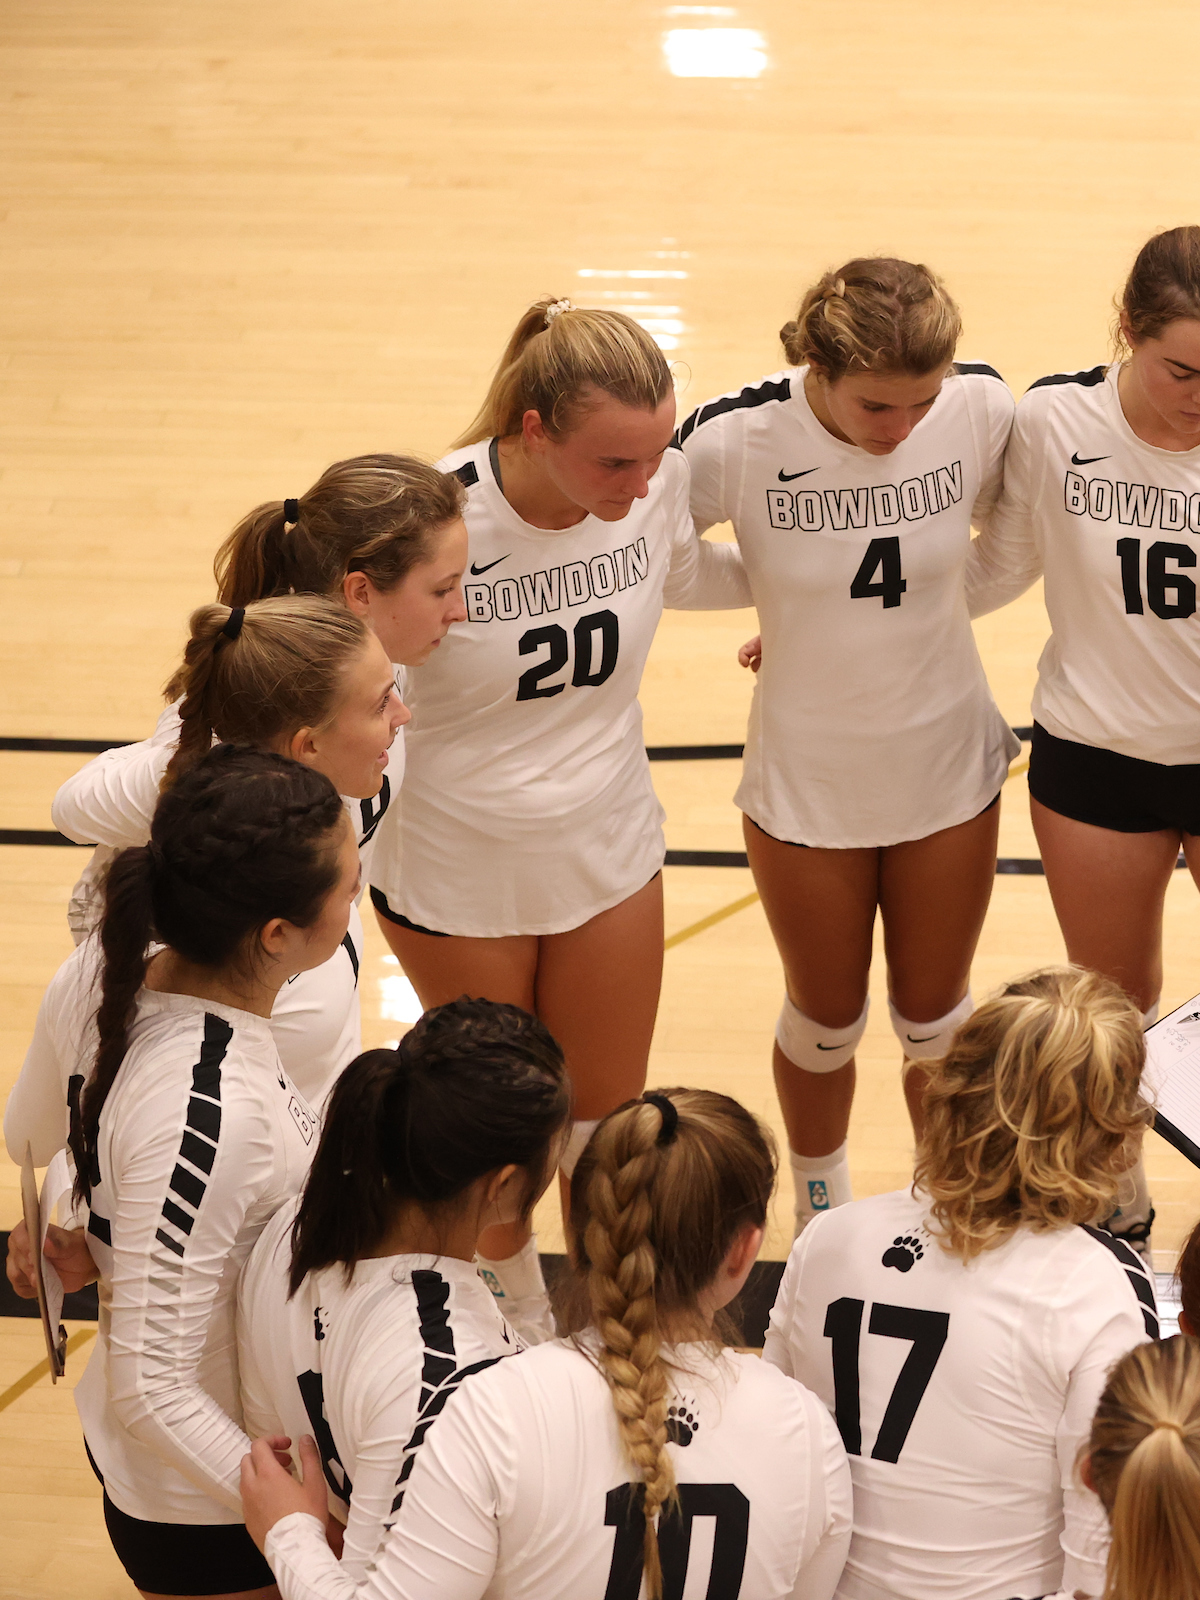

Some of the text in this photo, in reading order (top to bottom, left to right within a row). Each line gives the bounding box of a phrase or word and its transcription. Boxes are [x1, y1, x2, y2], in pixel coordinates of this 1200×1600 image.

[767, 460, 963, 532] BOWDOIN
[465, 537, 649, 623] BOWDOIN
[850, 536, 907, 609] 4
[1116, 537, 1197, 620] 16
[516, 609, 619, 701] 20
[823, 1297, 950, 1464] 17
[604, 1482, 750, 1600] 10
